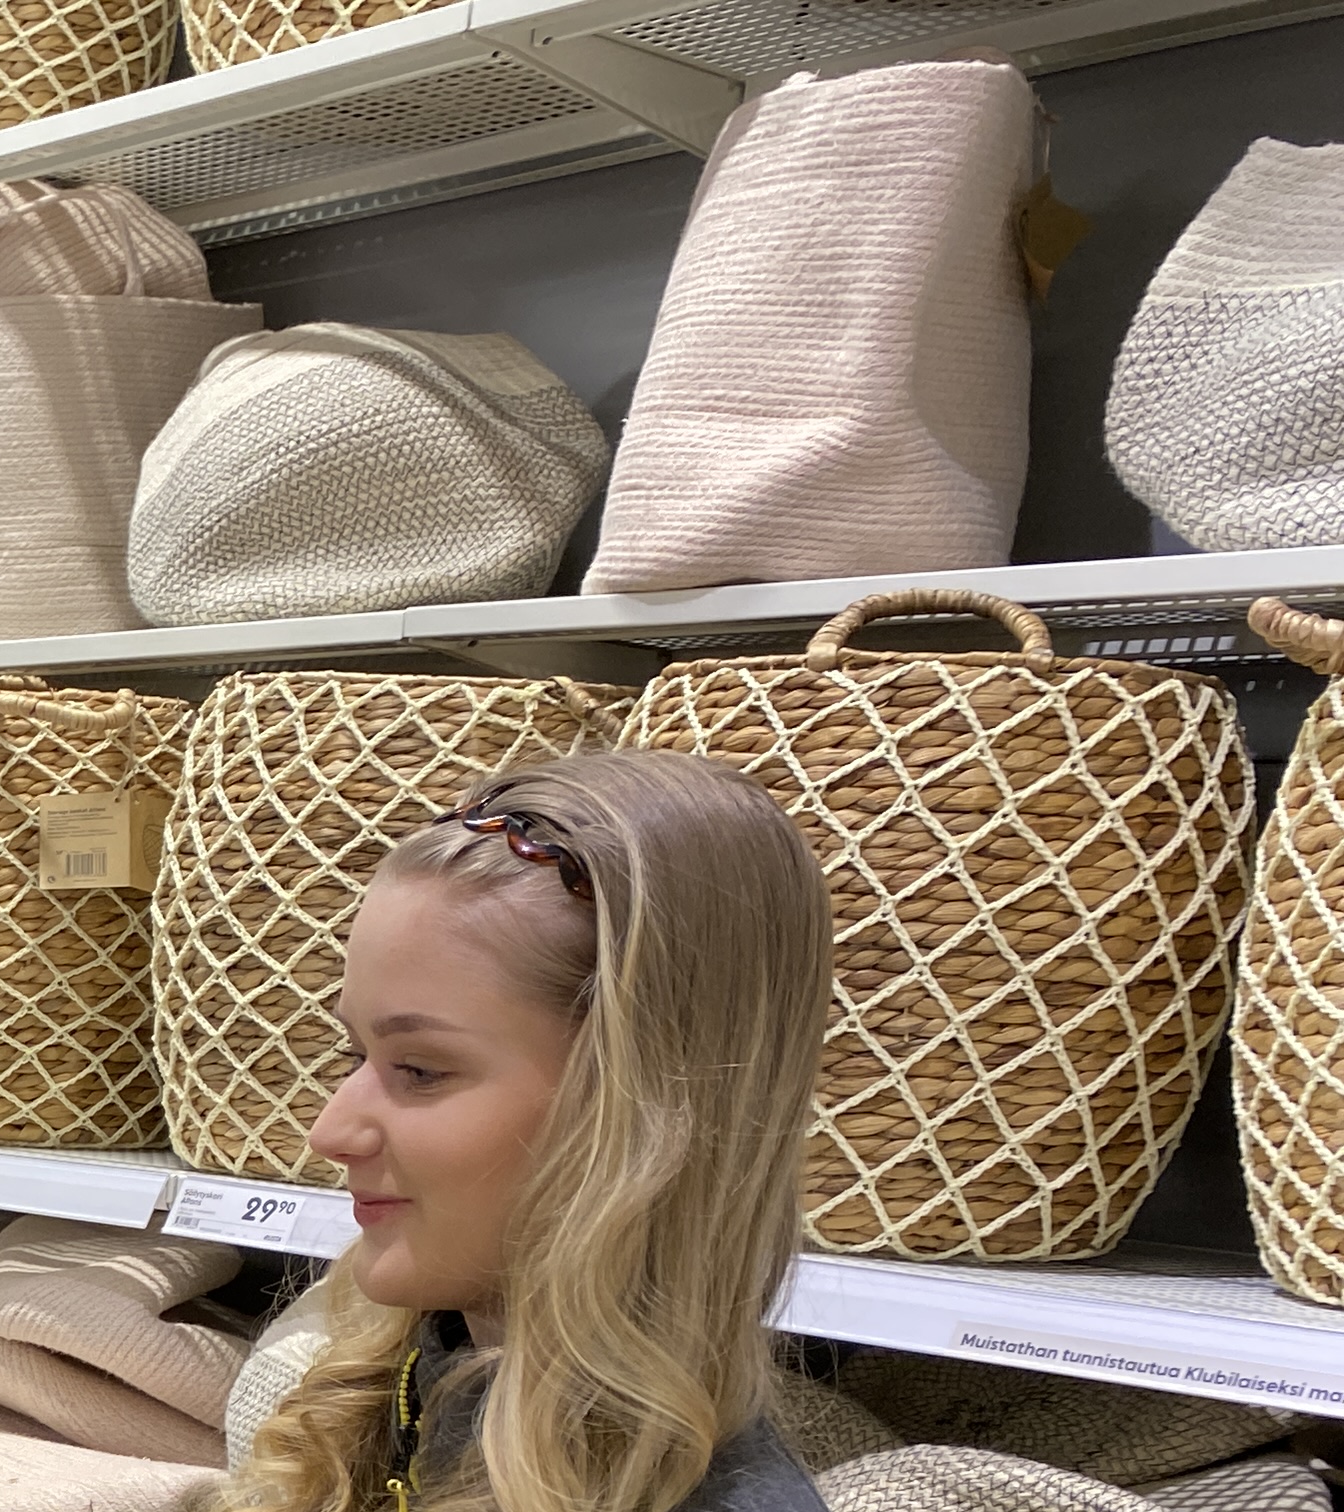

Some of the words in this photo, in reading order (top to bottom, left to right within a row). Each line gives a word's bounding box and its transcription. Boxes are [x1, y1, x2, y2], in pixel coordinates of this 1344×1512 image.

[960, 1332, 1059, 1360] Muistathan
[1061, 1348, 1181, 1379] tunnistautua
[1184, 1365, 1308, 1397] Klubilaiseksi
[1308, 1386, 1344, 1404] ma
